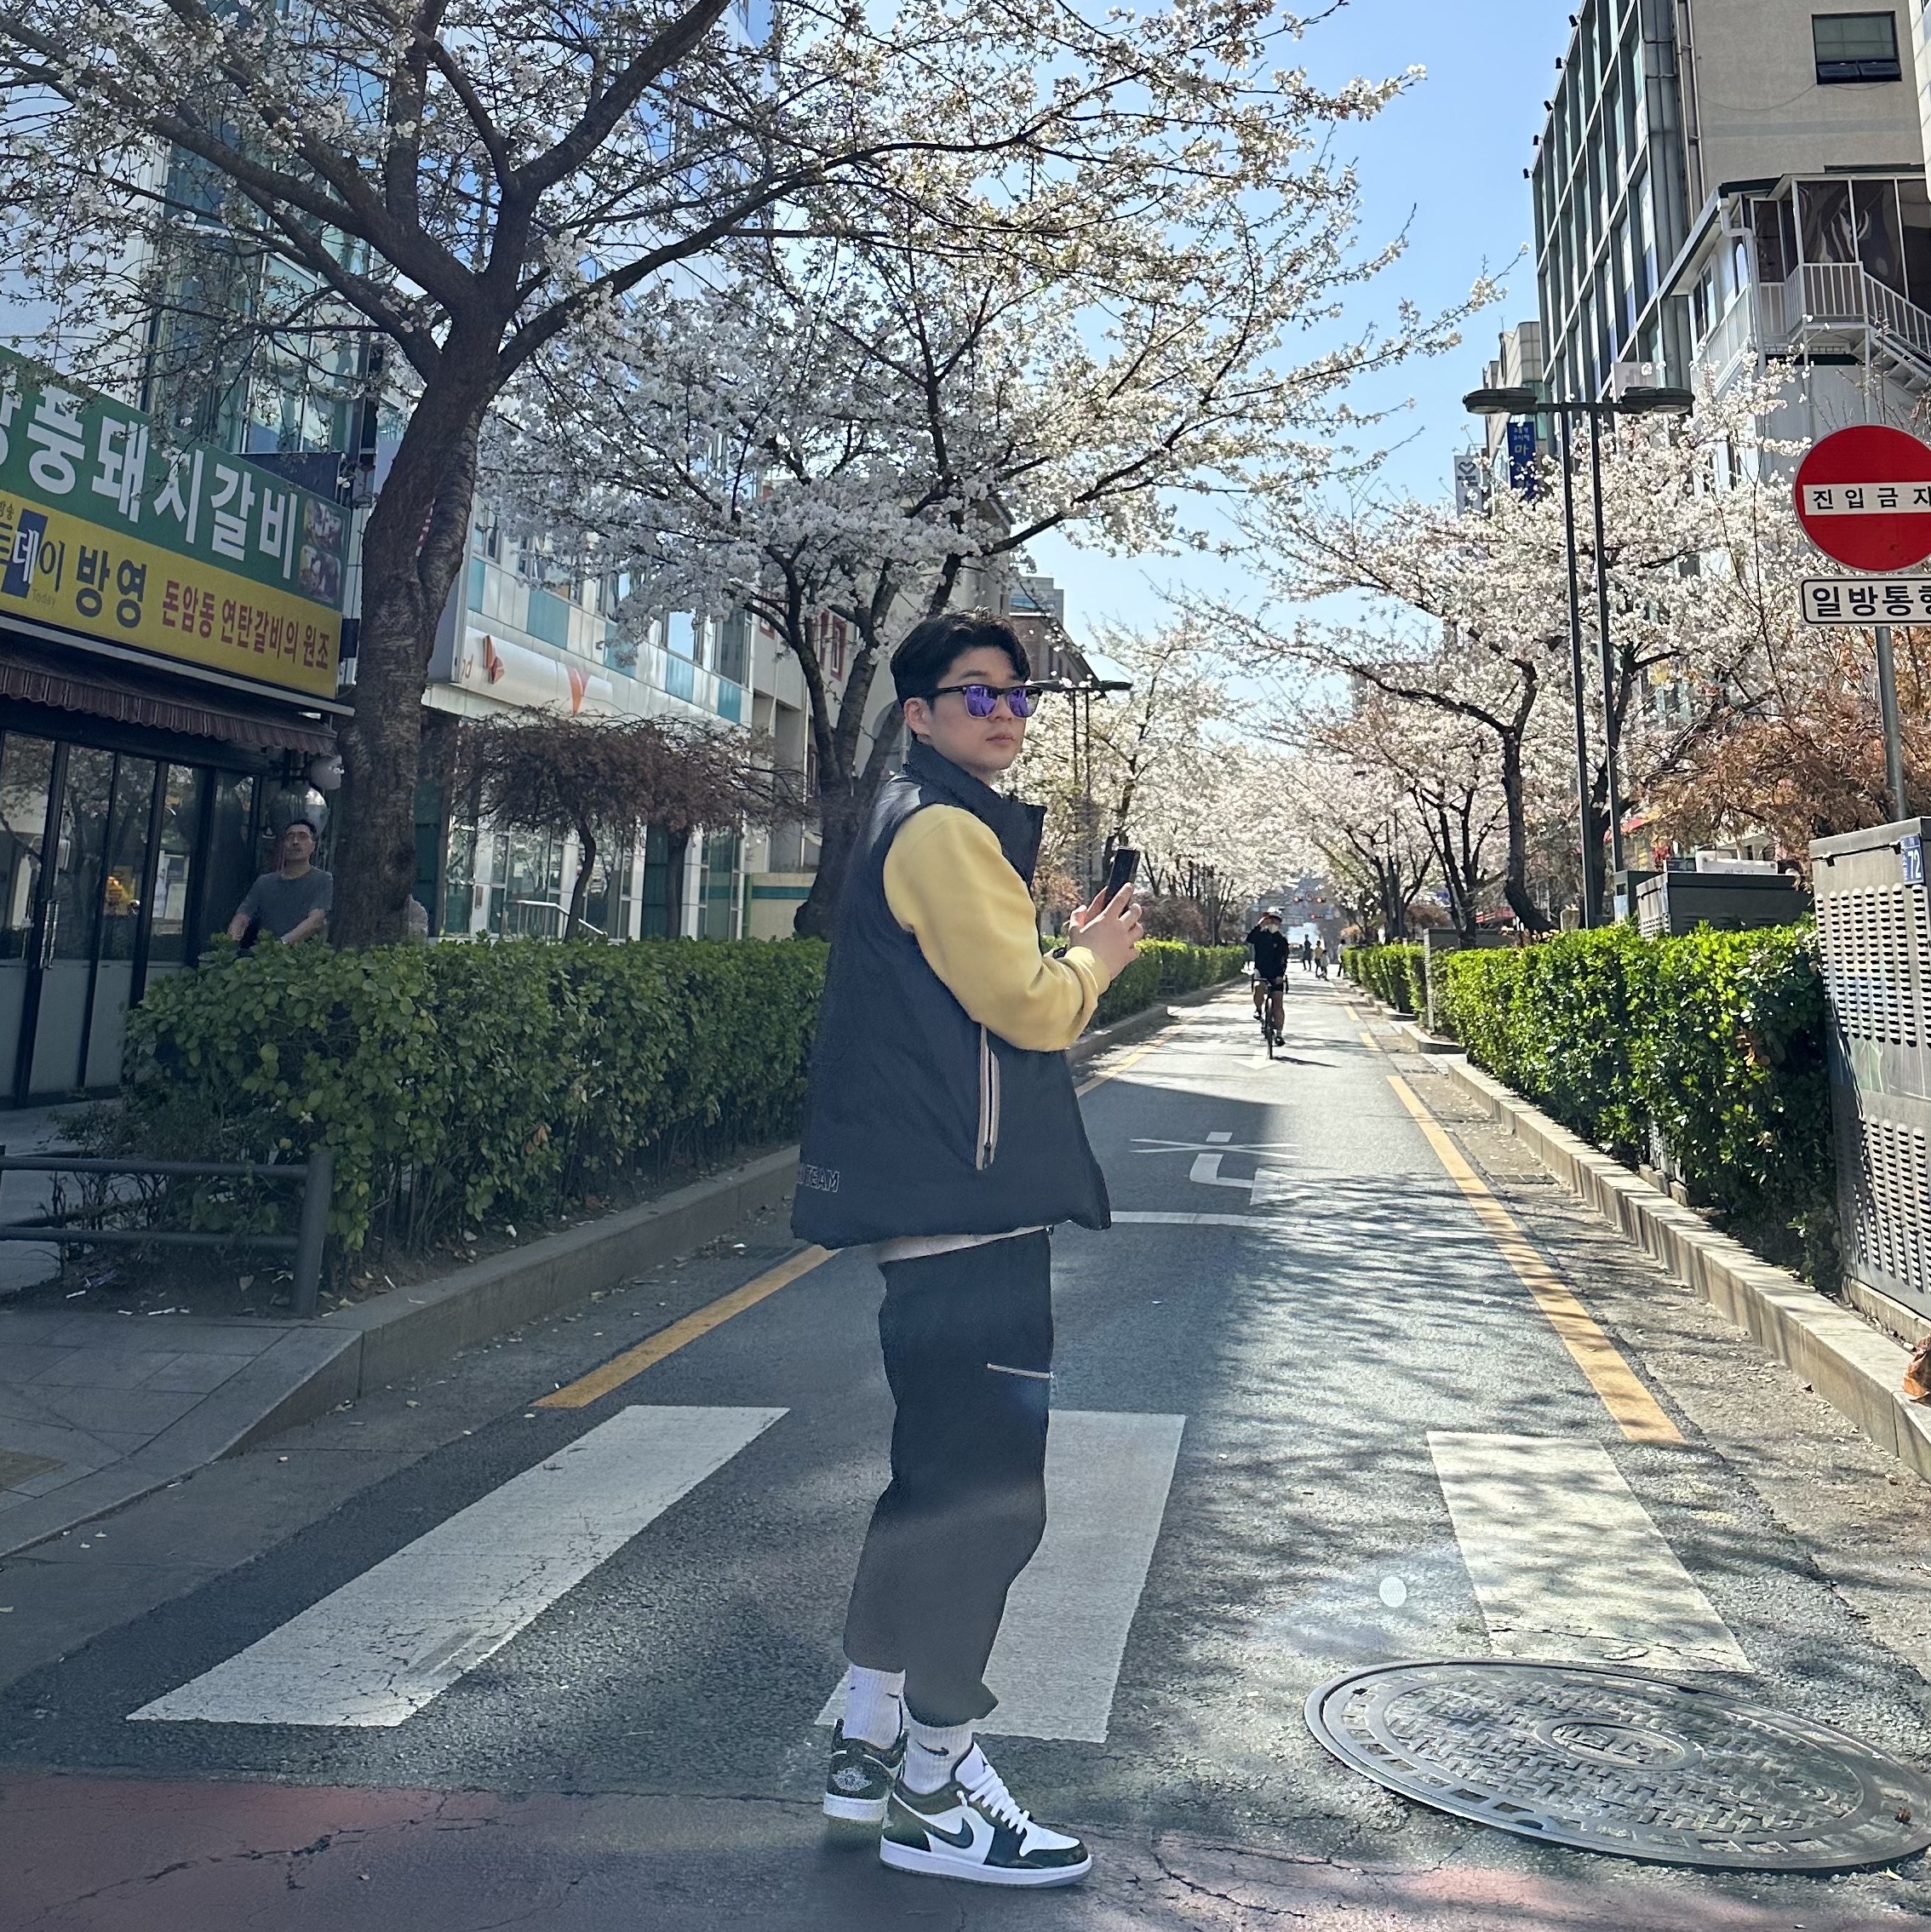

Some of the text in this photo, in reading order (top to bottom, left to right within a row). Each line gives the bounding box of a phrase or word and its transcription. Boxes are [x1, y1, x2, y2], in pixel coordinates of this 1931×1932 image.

[76, 543, 146, 628] 방영
[162, 580, 215, 639] 돈암동
[221, 599, 299, 664] 연탄갈비의
[303, 624, 330, 670] 원조
[1908, 849, 1922, 880] 72
